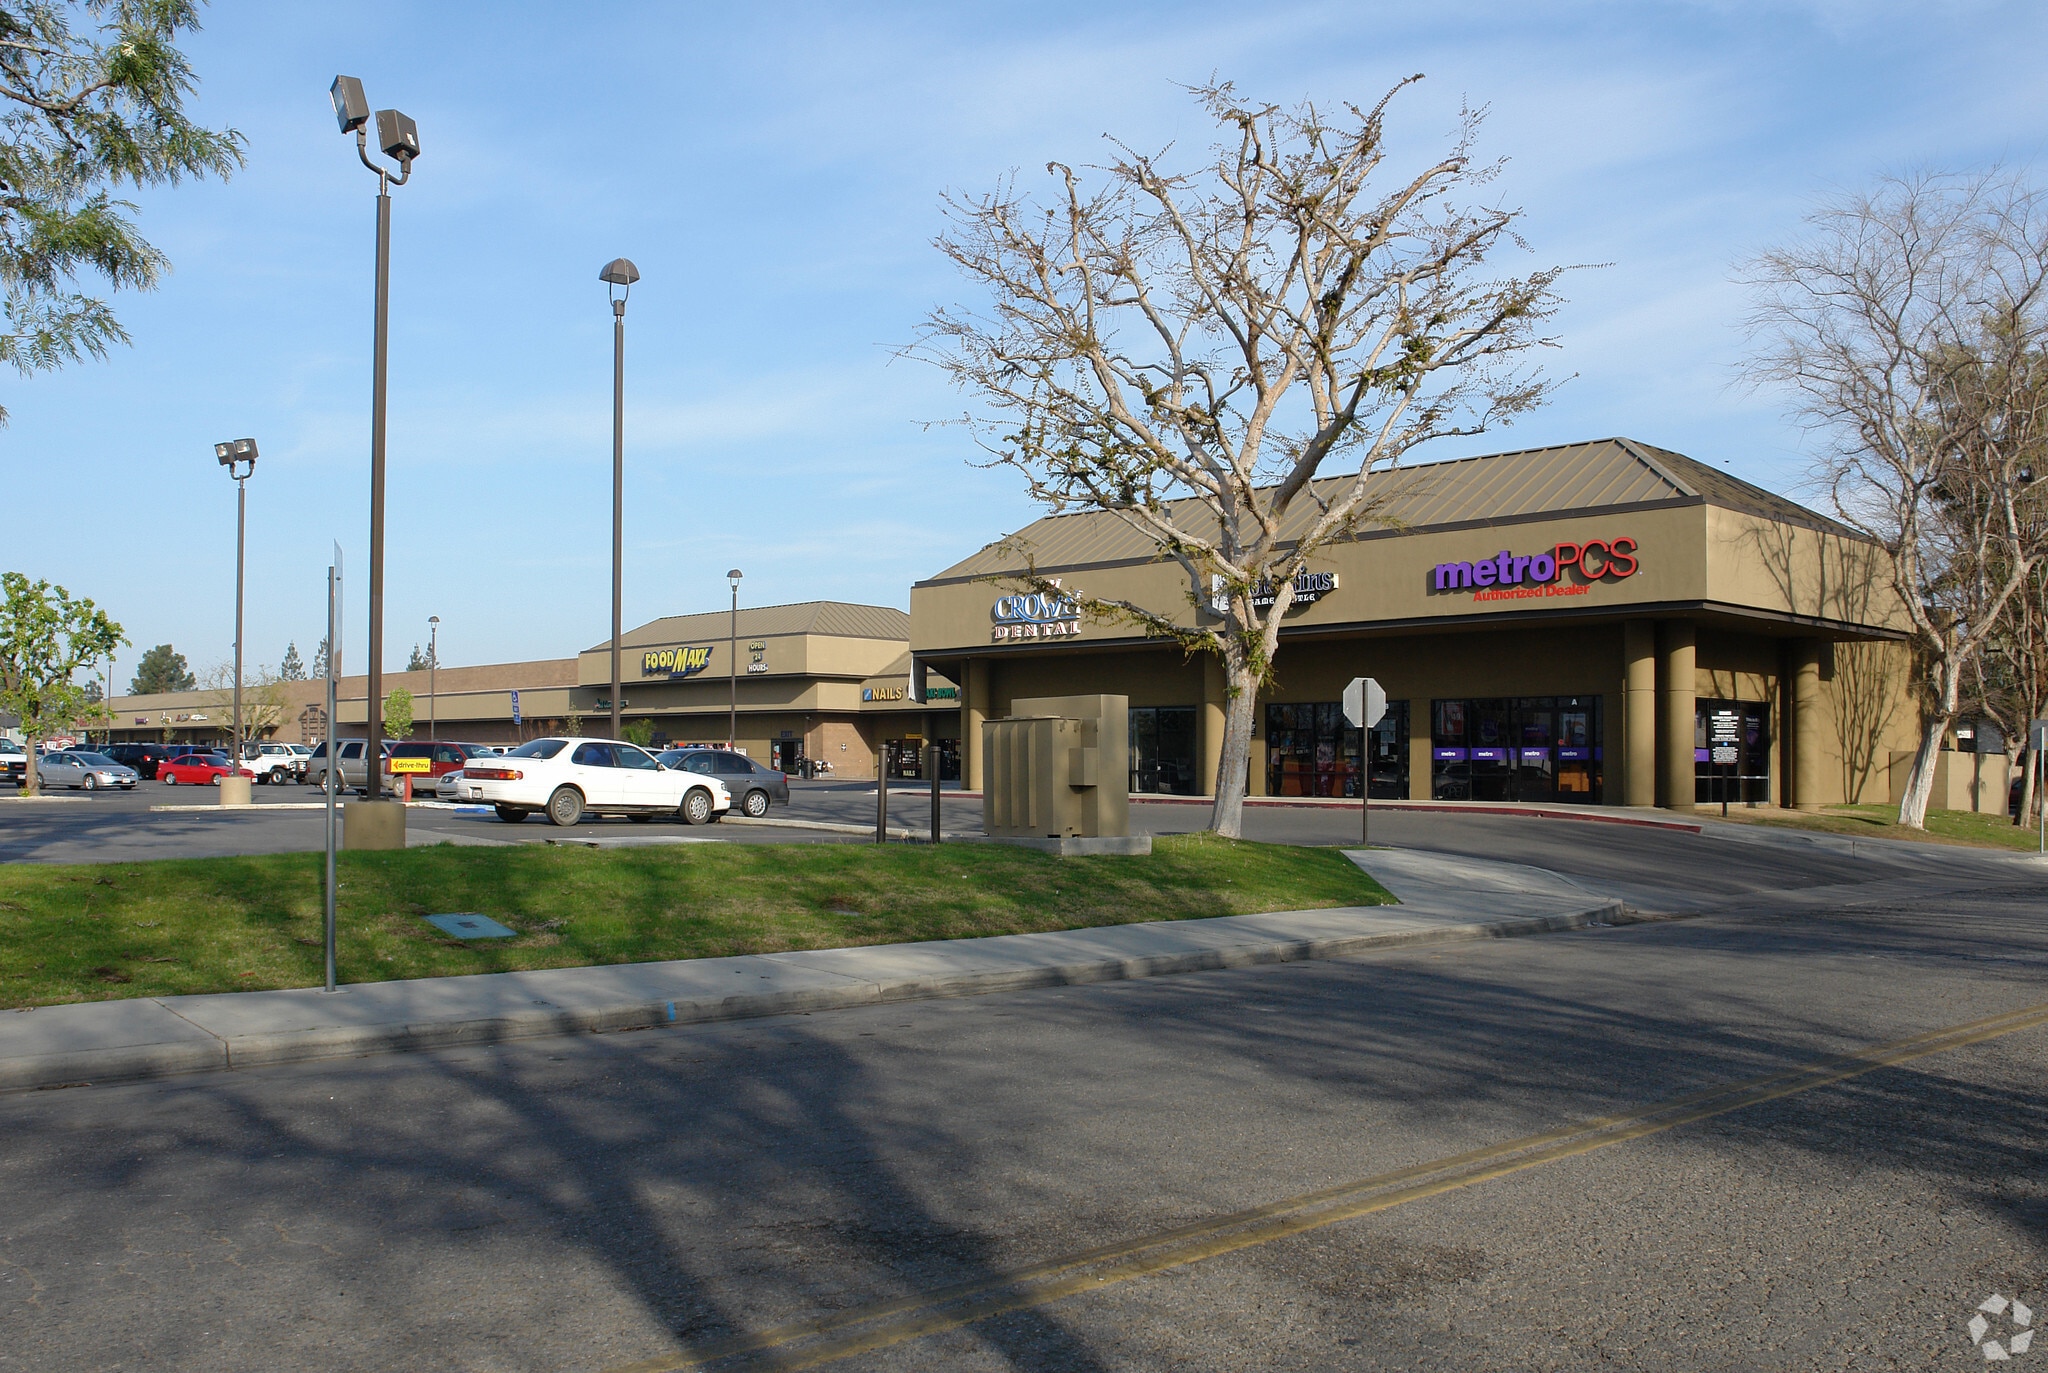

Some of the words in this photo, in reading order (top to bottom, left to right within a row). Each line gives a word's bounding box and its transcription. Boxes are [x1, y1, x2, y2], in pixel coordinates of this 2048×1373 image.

[1435, 537, 1637, 590] metroPCS
[1473, 586, 1543, 602] Authorized
[1545, 583, 1591, 598] Dealer
[994, 621, 1082, 639] DENTAL
[750, 641, 766, 651] OPEN
[748, 664, 768, 673] HOURS
[872, 687, 903, 701] NAILS
